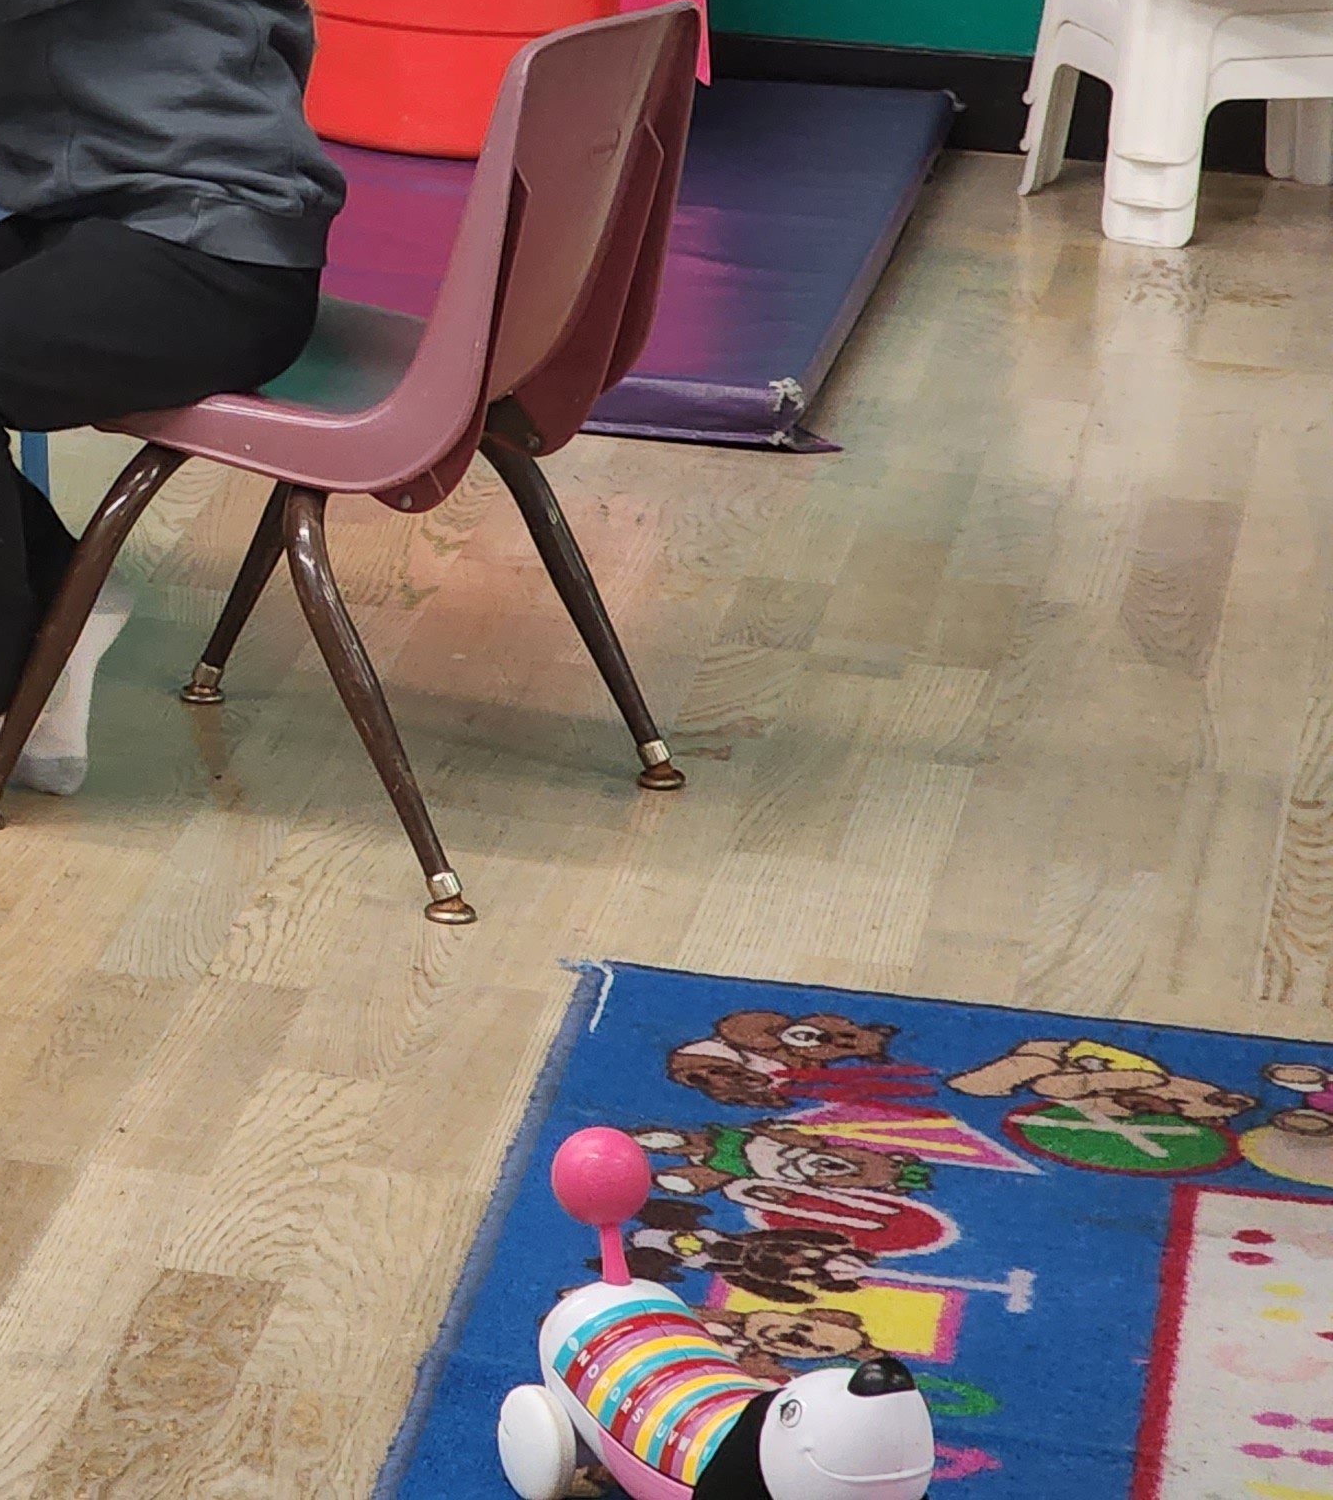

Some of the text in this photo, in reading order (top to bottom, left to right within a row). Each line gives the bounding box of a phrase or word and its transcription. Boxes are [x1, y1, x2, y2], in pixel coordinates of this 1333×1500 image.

[577, 1350, 590, 1367] N
[621, 1398, 632, 1414] R
[632, 1408, 644, 1423] S
[656, 1423, 668, 1438] U
[668, 1430, 679, 1446] V
